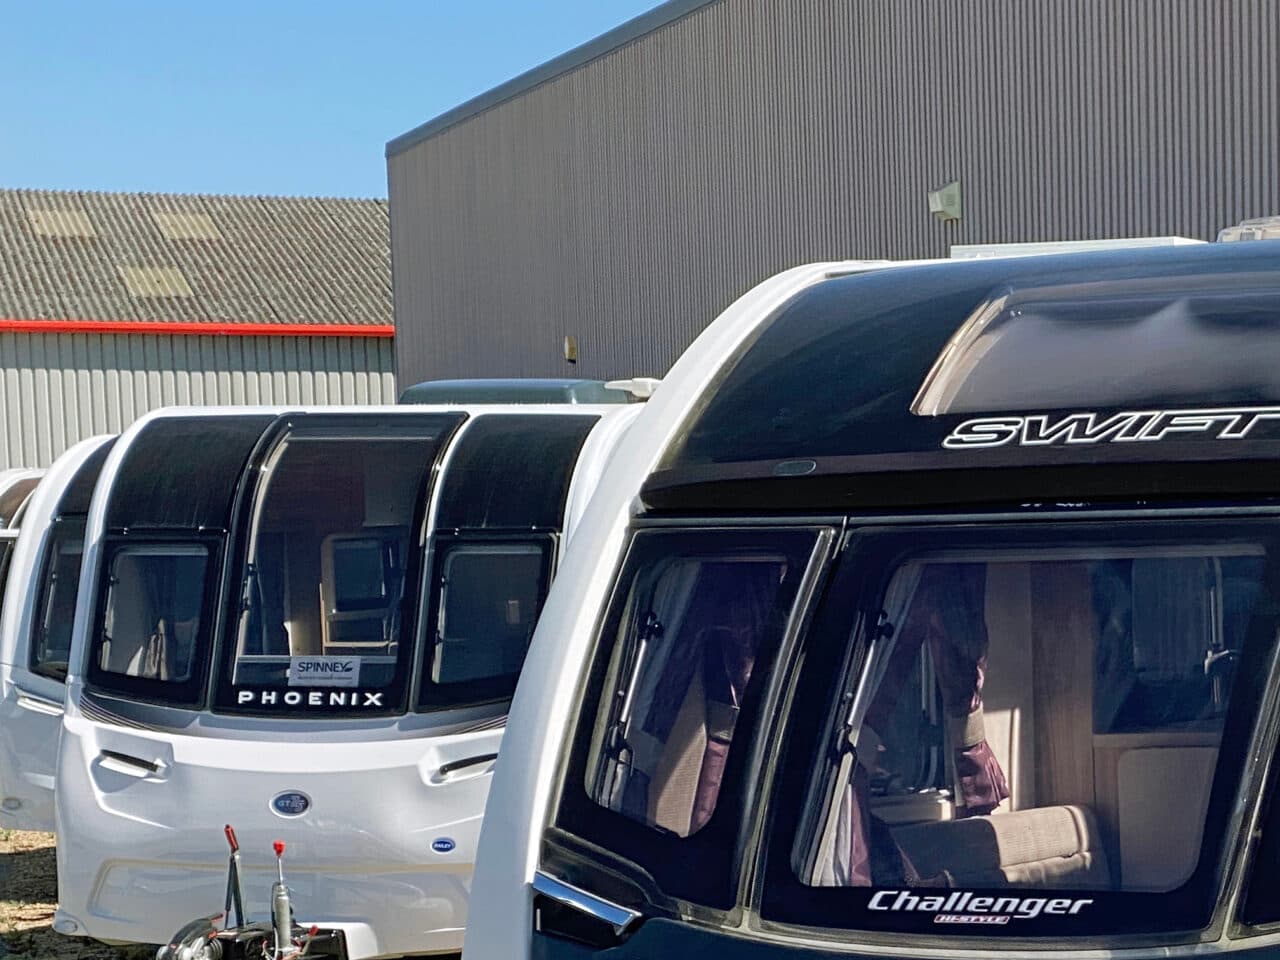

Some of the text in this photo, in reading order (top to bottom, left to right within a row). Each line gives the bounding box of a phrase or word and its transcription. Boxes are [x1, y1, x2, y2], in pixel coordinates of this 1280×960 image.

[298, 661, 352, 672] SPINNEY
[238, 691, 383, 706] PHOENIX
[867, 890, 1093, 918] Challenger
